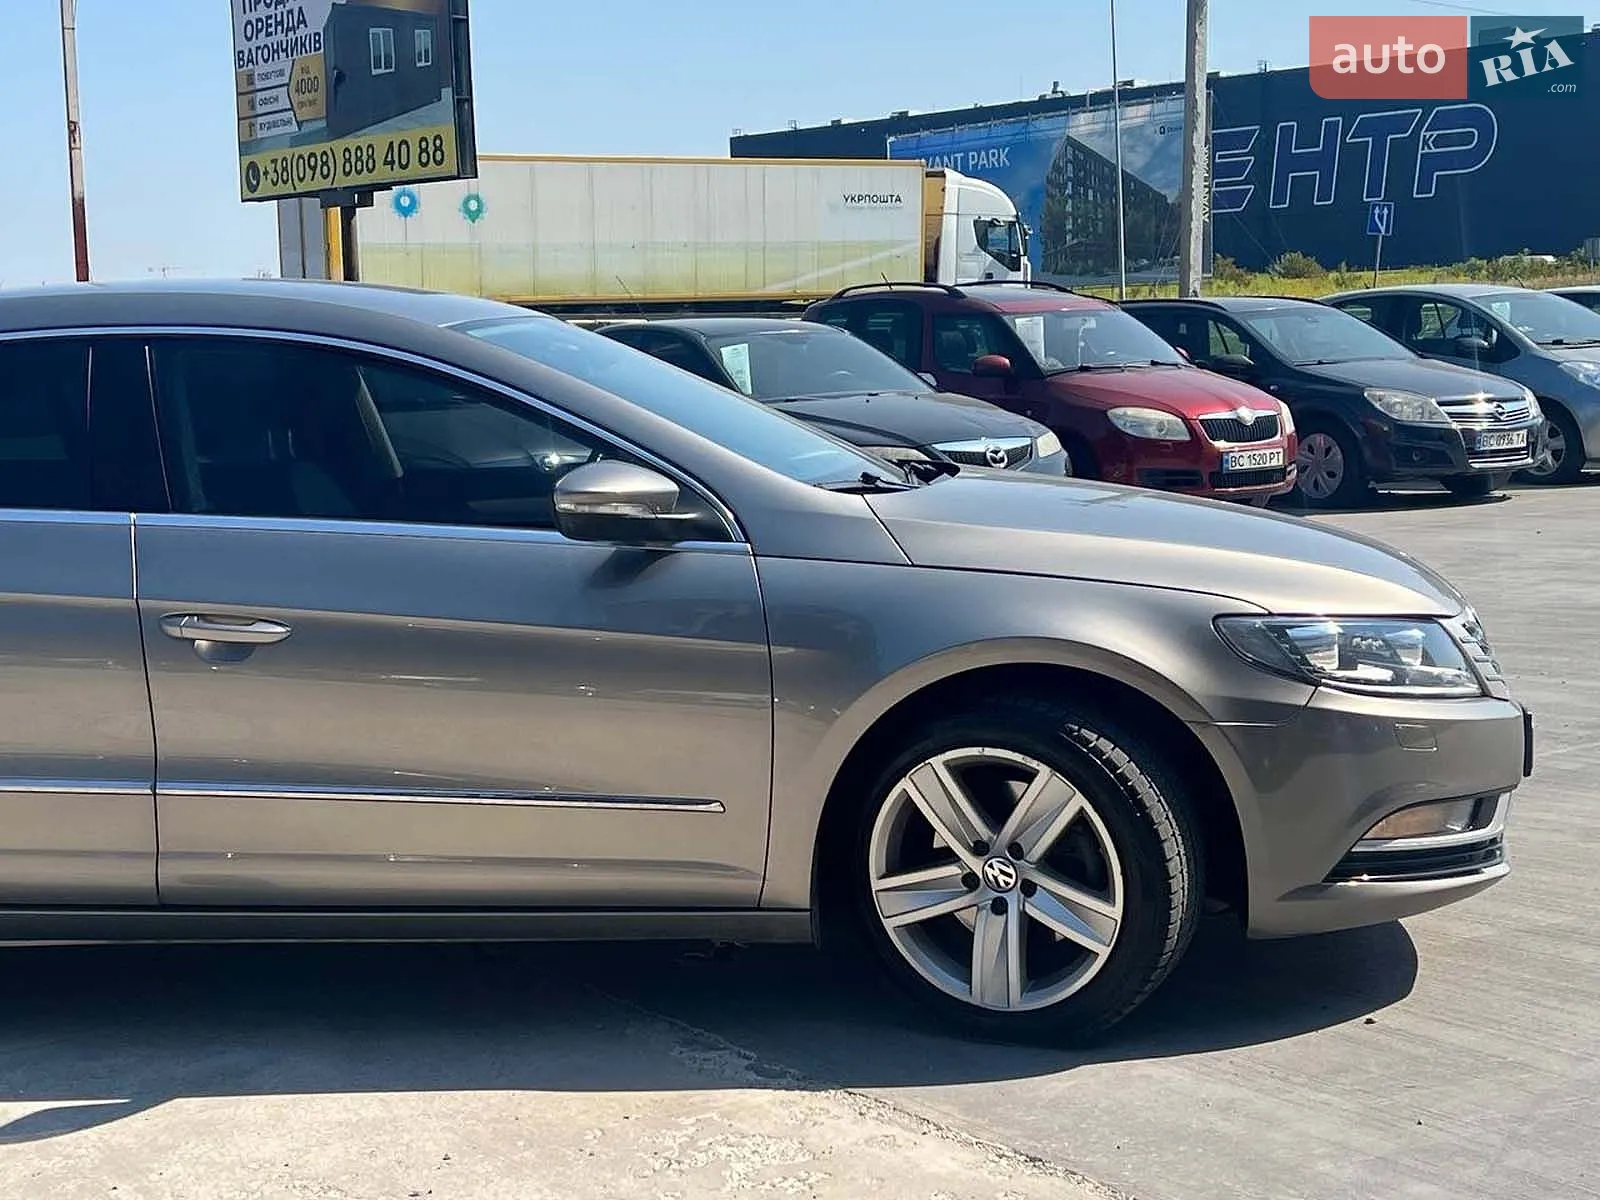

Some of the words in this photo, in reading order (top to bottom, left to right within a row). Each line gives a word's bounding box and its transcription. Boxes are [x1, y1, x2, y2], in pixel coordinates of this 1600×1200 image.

[243, 6, 308, 42] ОРЕНДА
[237, 32, 322, 69] ВАГОНЧИКІВ
[295, 75, 319, 97] 4000
[262, 146, 337, 190] +38(098)
[343, 143, 375, 177] 888
[384, 139, 410, 171] 40
[418, 135, 445, 168] 88
[921, 152, 964, 171] VANT
[968, 147, 1010, 171] PARK
[843, 194, 903, 204] УКРПОШТА
[1230, 455, 1245, 468] BC
[1248, 453, 1268, 466] 1520
[1269, 451, 1281, 464] PT
